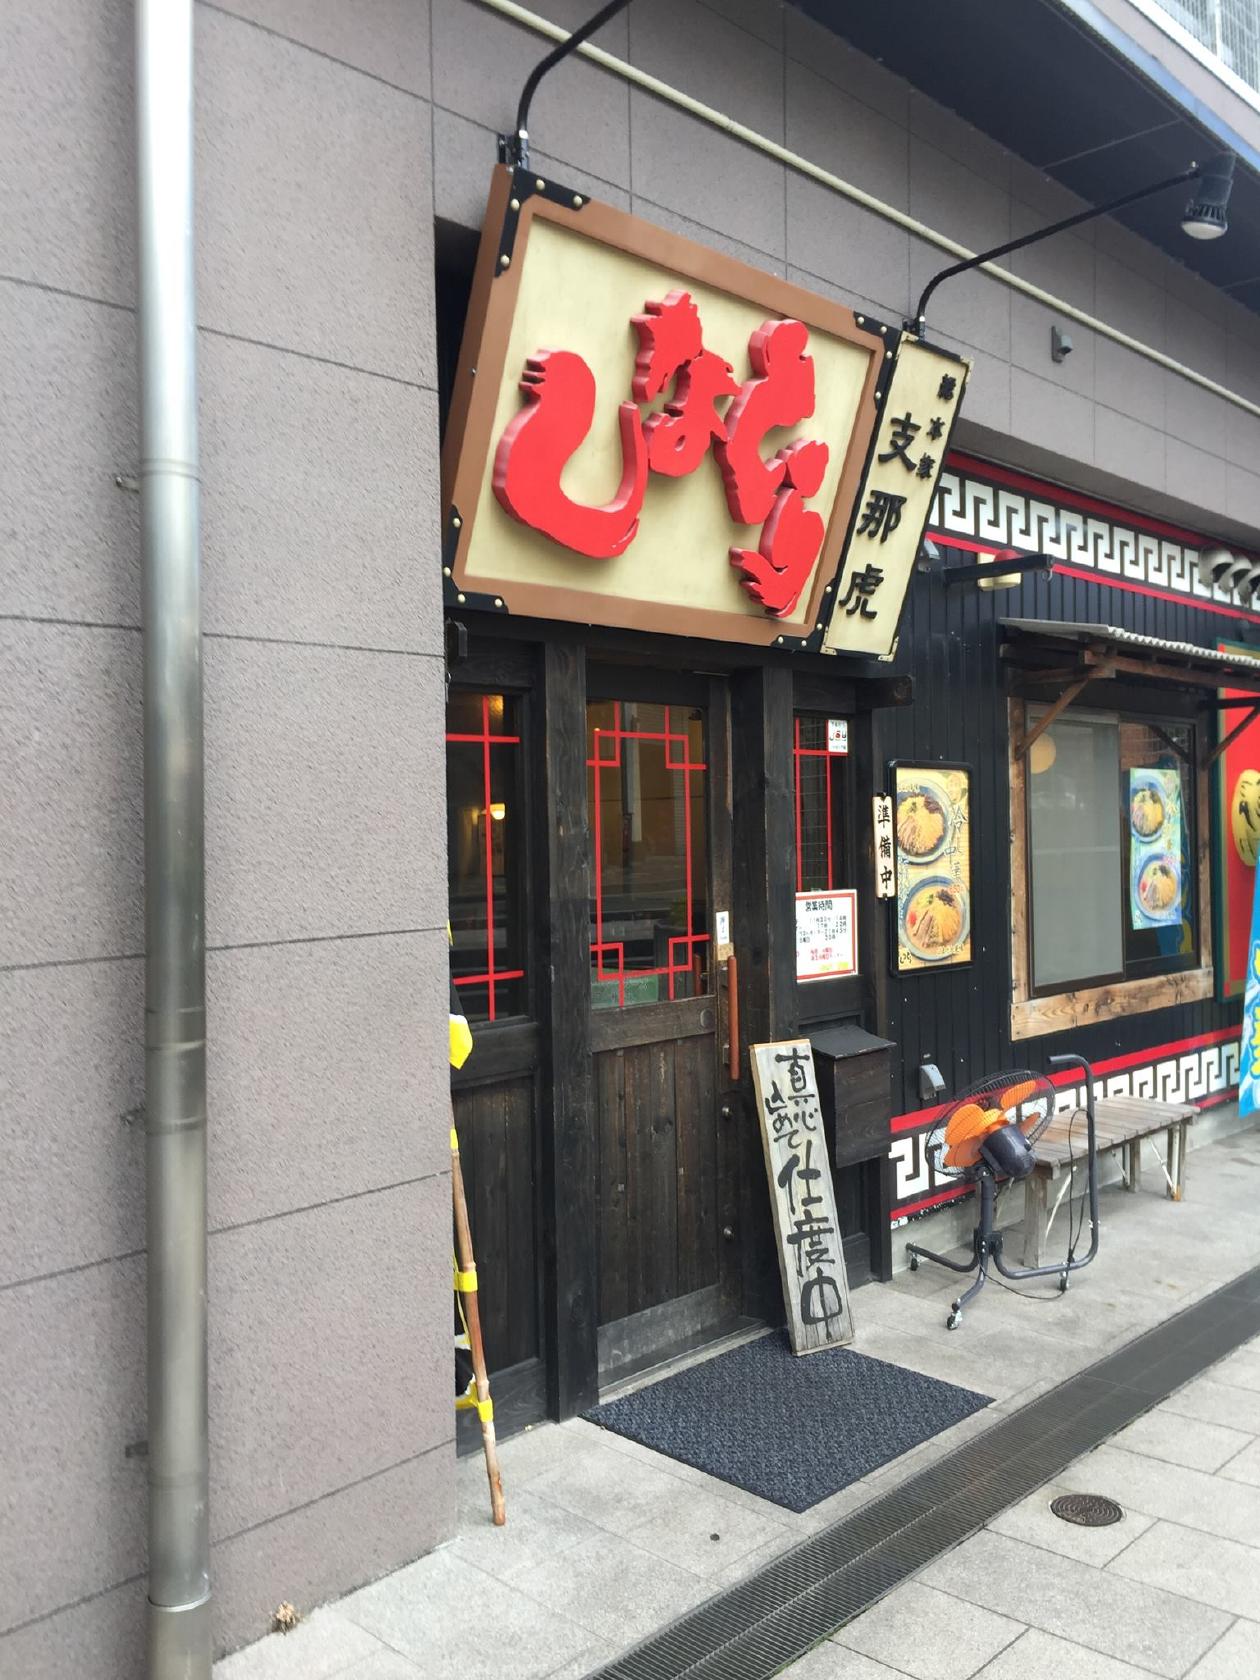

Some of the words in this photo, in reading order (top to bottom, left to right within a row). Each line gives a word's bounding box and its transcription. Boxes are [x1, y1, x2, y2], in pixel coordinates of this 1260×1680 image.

[838, 411, 921, 620] 支那虎
[805, 900, 833, 912] 営業時間
[878, 804, 893, 889] 準備中
[777, 1139, 843, 1342] 仕度中
